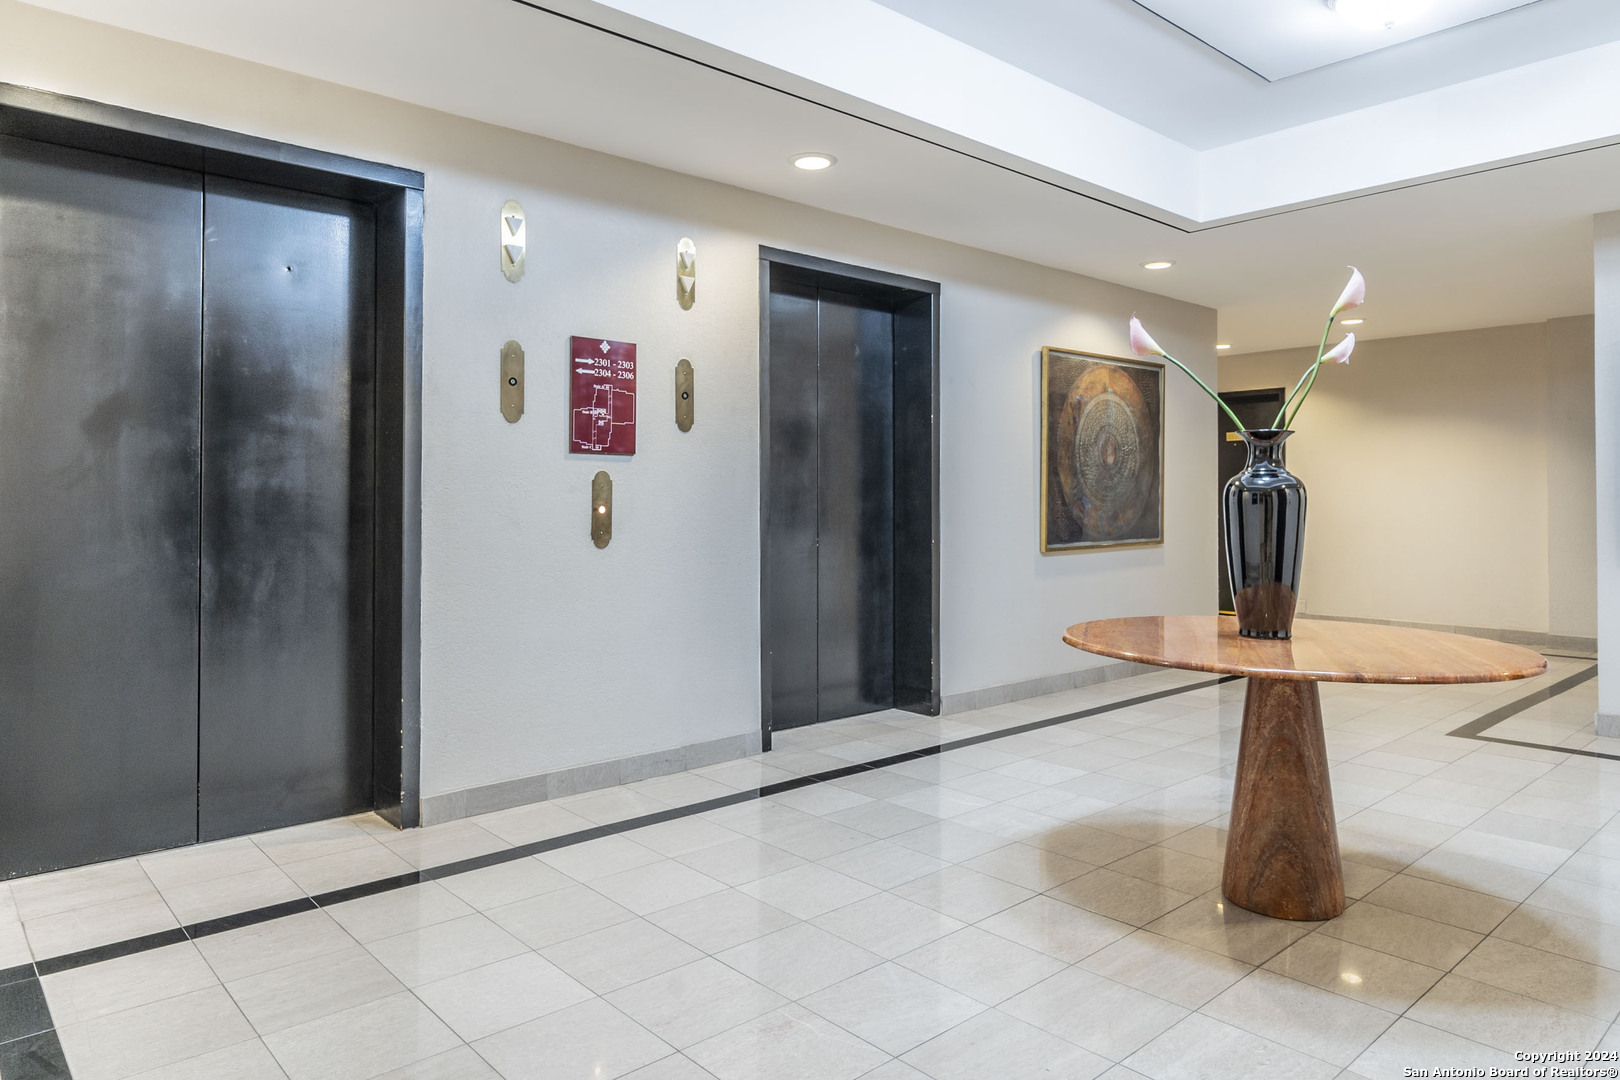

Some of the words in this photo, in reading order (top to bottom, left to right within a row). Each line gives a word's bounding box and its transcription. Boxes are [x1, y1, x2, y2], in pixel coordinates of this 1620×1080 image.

[594, 358, 611, 367] 2301
[617, 360, 634, 370] 2303
[594, 368, 611, 378] 2304
[617, 371, 634, 380] 2306
